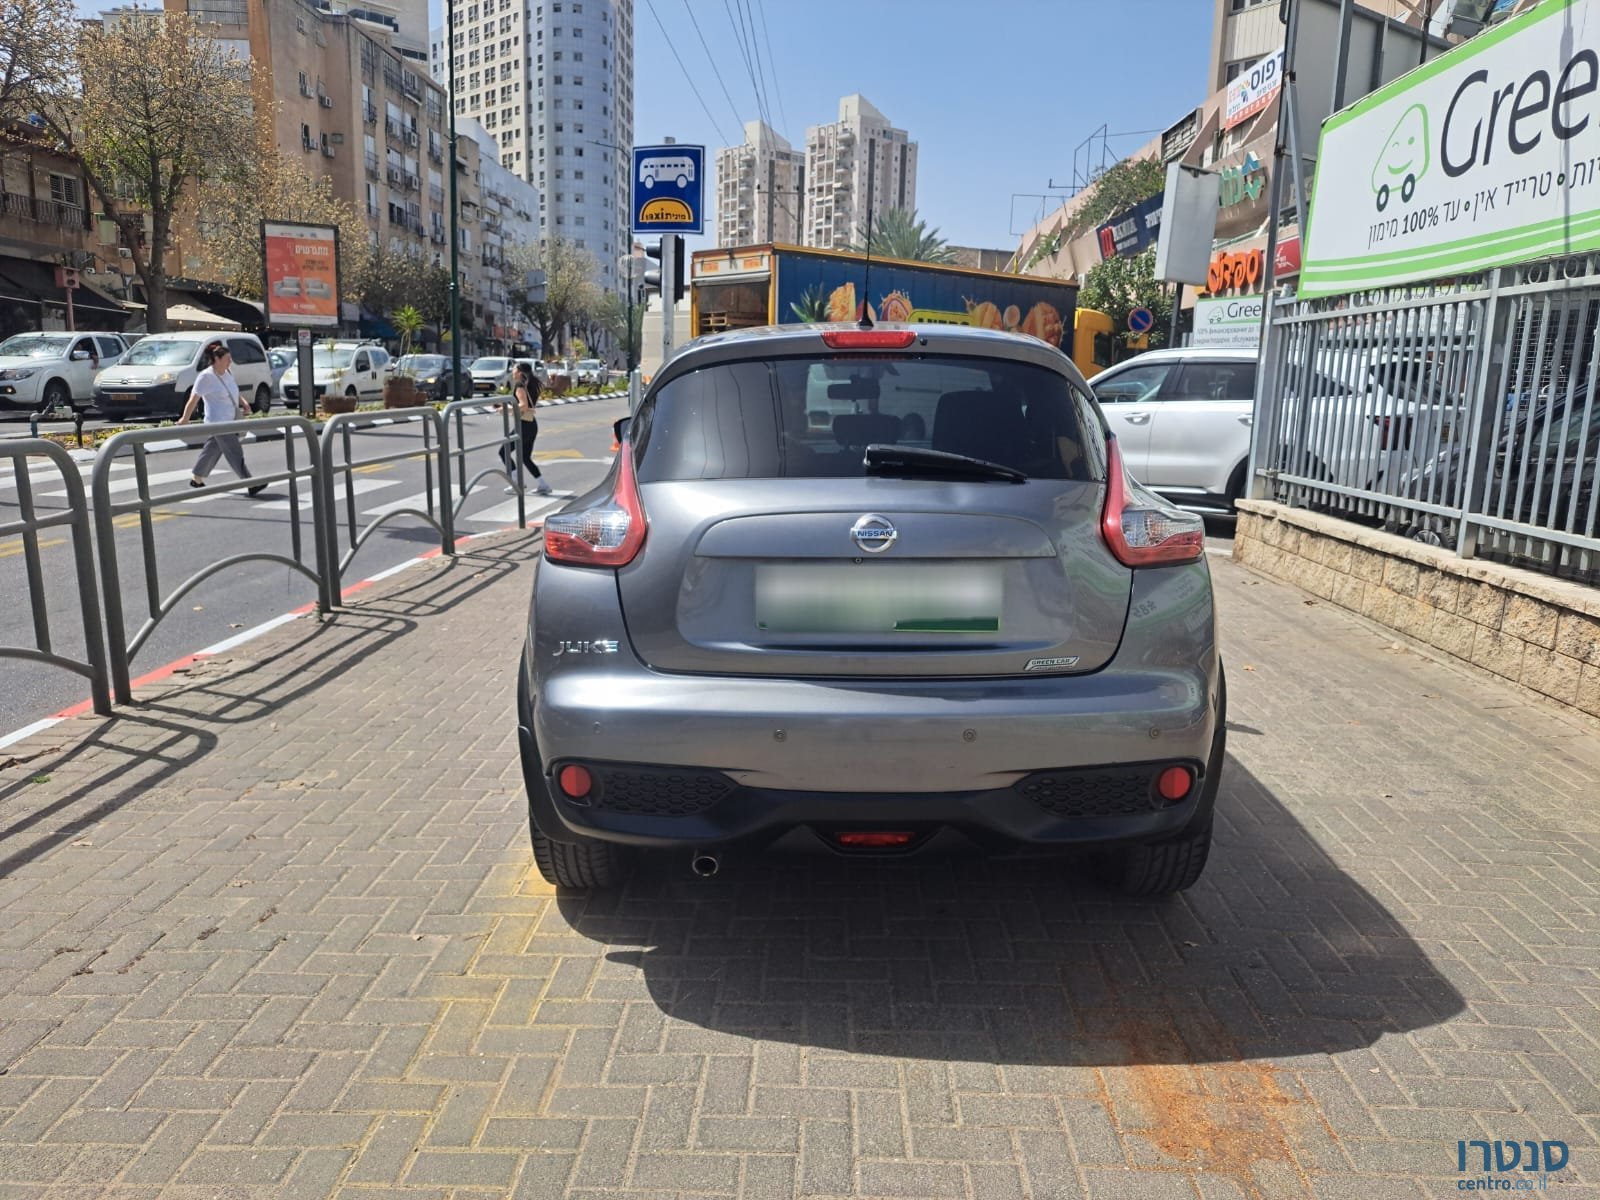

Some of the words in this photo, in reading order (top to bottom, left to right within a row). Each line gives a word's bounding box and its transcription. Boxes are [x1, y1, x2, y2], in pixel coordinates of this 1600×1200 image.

[1504, 171, 1552, 206] טרייד
[1444, 201, 1461, 224] עד
[1473, 187, 1498, 222] אין
[1368, 217, 1398, 249] מימון
[1402, 205, 1439, 235] 100%
[1227, 302, 1262, 318] Gree
[551, 639, 619, 657] JUKE
